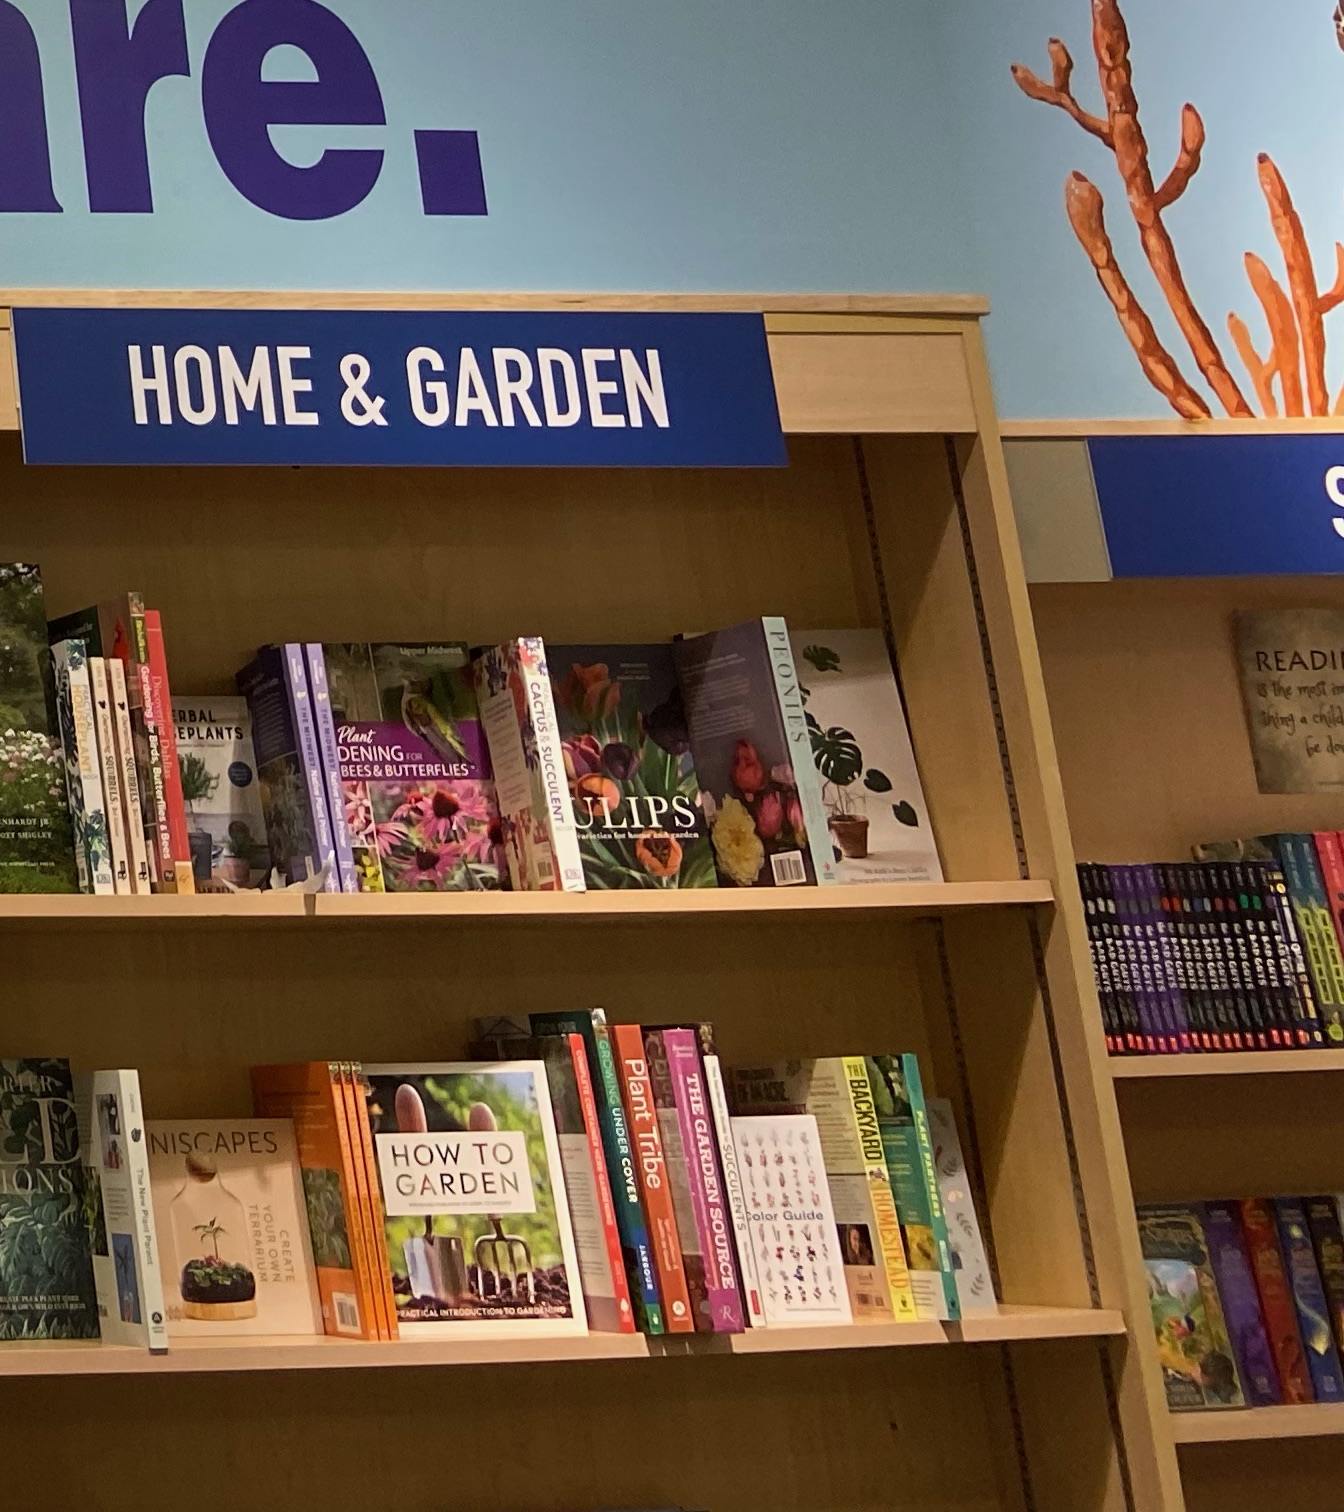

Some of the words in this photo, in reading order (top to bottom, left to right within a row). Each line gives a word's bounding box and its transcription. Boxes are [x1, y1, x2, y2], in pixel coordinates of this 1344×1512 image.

[129, 344, 320, 428] HOME
[338, 353, 389, 428] &
[406, 348, 670, 430] GARDEN
[770, 630, 808, 744] PEONIES
[338, 725, 376, 744] Plant
[530, 681, 546, 734] CACTUS
[541, 745, 564, 823] SUCCULENT
[341, 763, 371, 778] BEES
[373, 764, 383, 777] &
[572, 795, 696, 829] ULIPS
[685, 1073, 705, 1116] THE
[846, 1063, 865, 1078] THE
[598, 1039, 618, 1107] GROWING
[612, 1107, 628, 1156] UNDER
[621, 1157, 638, 1204] COVER
[624, 1058, 652, 1122] Plant
[638, 1129, 663, 1190] Tribe
[849, 1079, 883, 1162] BACKYARD
[391, 1143, 461, 1167] HOW
[472, 1142, 514, 1165] TO
[694, 1119, 721, 1205] GARDEN
[395, 1171, 520, 1197] GARDEN
[722, 1143, 748, 1231] SUCCULENTS
[248, 1203, 269, 1283] TERRARIUM
[263, 1204, 277, 1244] YOUR
[783, 1210, 824, 1222] Guide
[870, 1189, 908, 1290] HOMESTEAD
[269, 1246, 282, 1283] OWN
[279, 1229, 296, 1283] CREATE
[709, 1208, 735, 1290] SOURCE
[504, 1307, 516, 1315] TO
